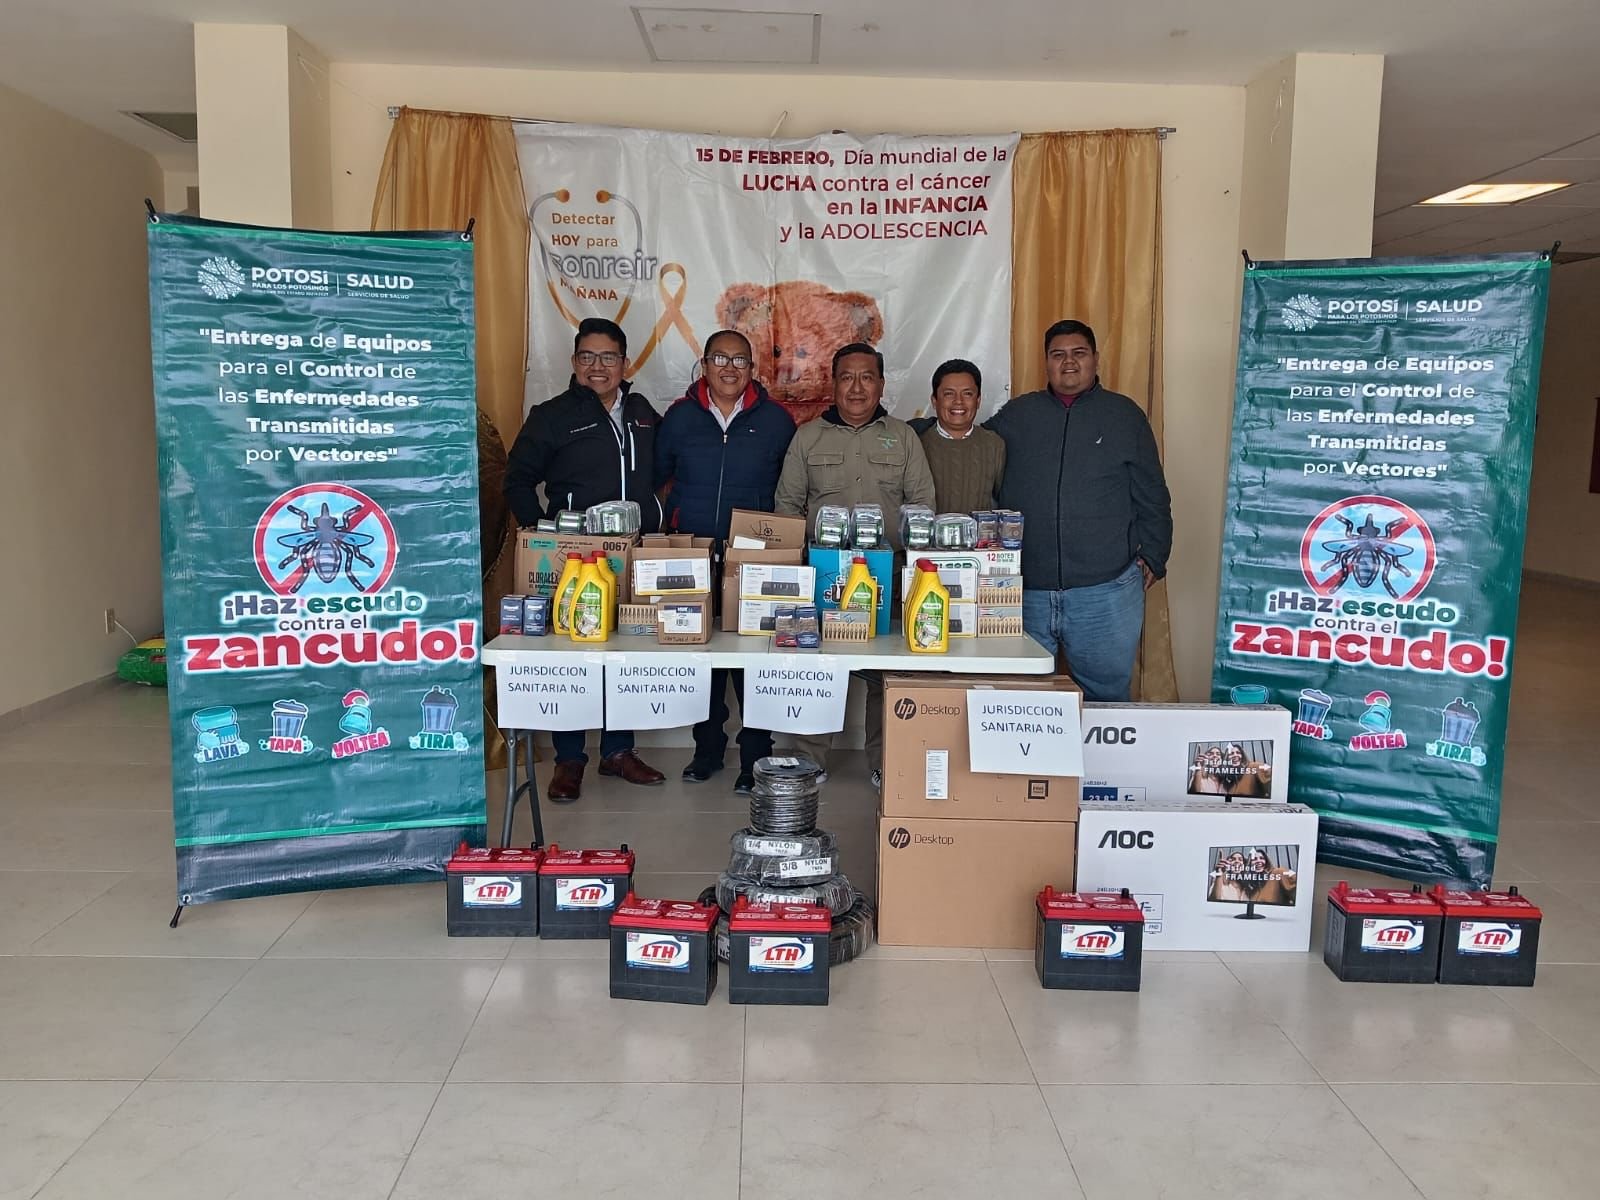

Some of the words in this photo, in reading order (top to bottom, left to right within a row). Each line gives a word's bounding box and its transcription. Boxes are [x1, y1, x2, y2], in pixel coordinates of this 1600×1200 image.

[696, 148, 713, 163] 15
[719, 149, 743, 163] DE
[748, 150, 835, 167] FEBRERO,
[844, 150, 873, 165] Día
[880, 147, 957, 165] mundial
[963, 147, 987, 162] de
[993, 146, 1007, 161] la
[743, 174, 816, 191] LUCHA
[822, 176, 889, 191] contra
[895, 174, 914, 190] el
[921, 173, 991, 189] cáncer
[827, 201, 853, 215] en
[860, 198, 878, 215] la
[885, 195, 988, 215] INFANCIA
[551, 212, 616, 225] Detectar
[779, 226, 792, 243] y
[799, 223, 815, 239] la
[820, 219, 988, 240] ADOLESCENCIA
[551, 234, 580, 246] HOY
[586, 237, 618, 249] para
[252, 282, 271, 290] PARA
[347, 274, 414, 290] SALUD
[560, 278, 618, 300] MÑANA
[1415, 300, 1482, 313] SALUD
[199, 328, 303, 350] "Entrega
[310, 333, 336, 348] de
[343, 334, 432, 353] Equipos
[219, 362, 268, 378] para
[275, 359, 294, 375] el
[300, 361, 384, 379] Control
[390, 363, 416, 379] de
[1277, 358, 1367, 373] "Entrega
[1374, 357, 1400, 371] de
[1405, 356, 1494, 373] Equipos
[218, 387, 249, 404] las
[255, 389, 419, 407] Enfermedades
[1290, 386, 1333, 400] para
[1339, 383, 1356, 397] el
[1362, 383, 1441, 398] Control
[1448, 384, 1475, 398] de
[1287, 409, 1312, 423] las
[1318, 409, 1475, 426] Enfermedades
[246, 417, 395, 435] Transmitidas
[1307, 434, 1446, 452] Transmitidas
[246, 449, 282, 465] por
[287, 447, 398, 463] Vectores"
[1303, 463, 1337, 477] por
[1342, 461, 1447, 478] Vectores"
[603, 541, 627, 552] 0067
[987, 553, 996, 561] 12
[224, 595, 297, 621] ¡Haz
[306, 591, 422, 613] escudo
[1268, 591, 1333, 613] ¡Haz
[1342, 598, 1456, 623] escudo
[278, 617, 344, 632] contra
[350, 615, 367, 629] el
[1314, 617, 1376, 633] contra
[1381, 621, 1398, 634] el
[187, 621, 475, 671] zancudo!
[1232, 623, 1506, 677] zancudo!
[509, 666, 587, 677] JURISDICCION
[619, 666, 696, 678] JURISDICCION
[757, 668, 833, 682] JURISDICCION
[508, 683, 567, 694] SANITARIA
[570, 684, 589, 695] No.
[617, 683, 676, 694] SANITARIA
[679, 683, 698, 694] No.
[755, 685, 813, 698] SANITARIA
[816, 686, 835, 698] No.
[539, 702, 559, 715] VII
[650, 702, 665, 715] VI
[787, 705, 802, 718] IV
[896, 698, 915, 720] hp
[920, 703, 960, 716] Desktop
[982, 704, 1063, 717] JURISDICCION
[981, 721, 1043, 734] SANITARIA
[1047, 724, 1067, 735] No.
[1084, 726, 1137, 744] AOC
[1293, 721, 1324, 738] TAPA
[269, 737, 303, 752] TAPA
[332, 731, 389, 758] VOLTEA
[419, 733, 454, 748] TIRA
[1350, 733, 1406, 750] VOLTEA
[203, 744, 240, 761] LAVA
[1020, 743, 1031, 756] V
[1435, 740, 1472, 763] TIRA
[747, 840, 762, 848] 1/4
[768, 841, 796, 850] NYLON
[891, 827, 909, 848] hp
[914, 833, 954, 845] Desktop
[1098, 830, 1154, 849] AOC
[781, 861, 798, 871] 3/8
[1225, 873, 1281, 881] FRAMELESS
[478, 886, 509, 898] LTH
[571, 888, 602, 900] LTH
[1077, 935, 1110, 948] LTH
[1377, 930, 1409, 942] LTH
[1474, 932, 1506, 945] LTH
[641, 943, 675, 959] LTH
[765, 947, 800, 961] LTH
